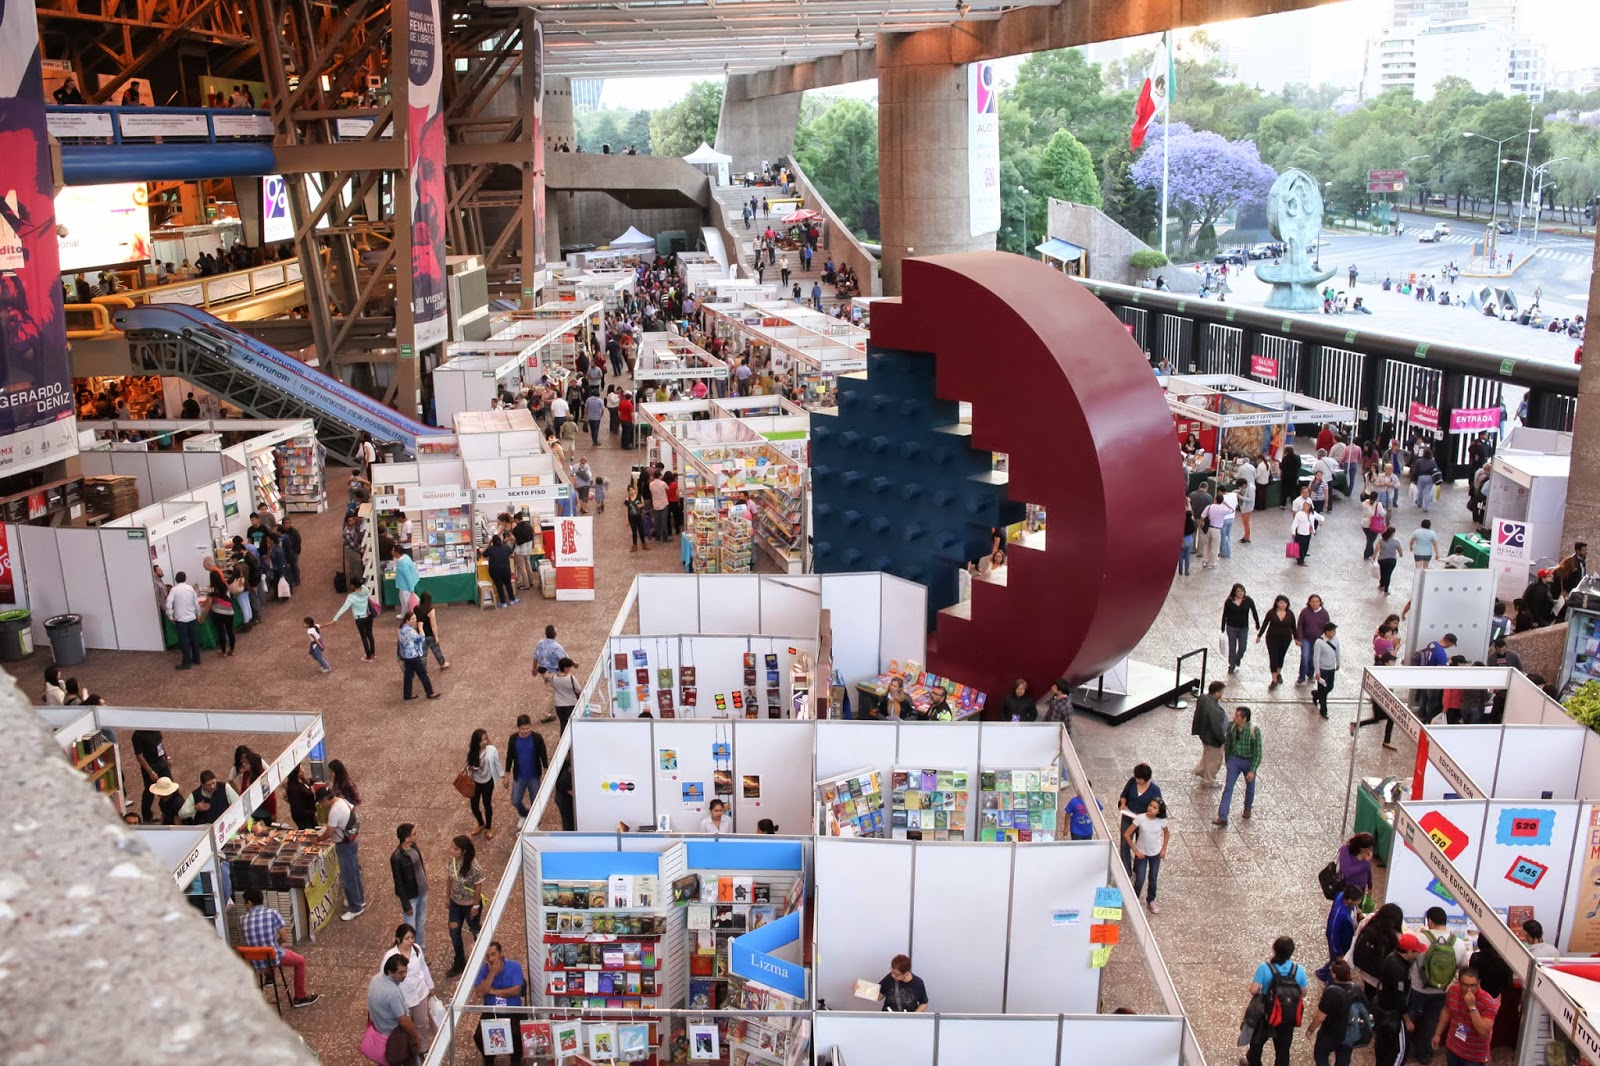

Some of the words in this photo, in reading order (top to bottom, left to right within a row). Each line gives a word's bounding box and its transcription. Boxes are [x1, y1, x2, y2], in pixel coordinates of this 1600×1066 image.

[410, 20, 434, 35] REMATE
[410, 31, 417, 42] DE
[0, 382, 62, 409] GERARDO
[256, 361, 290, 383] HYUNDAI
[300, 384, 316, 397] NEW
[348, 409, 364, 421] NEW
[271, 355, 305, 375] HYUNDAI
[314, 377, 329, 389] NEW
[361, 402, 377, 413] NEW
[36, 391, 70, 413] DENIZ
[1456, 415, 1493, 423] ENTRADA
[422, 492, 455, 500] PARANINFO
[1366, 681, 1384, 704] ESTUDIOS
[1390, 704, 1410, 733] MUJERES
[1373, 680, 1408, 718] DOCUMENTACION
[1439, 756, 1462, 788] EDICIONES
[1463, 784, 1473, 799] EON
[1515, 822, 1537, 830] $20
[1430, 833, 1447, 849] $30
[176, 849, 199, 880] MEXICO
[1518, 864, 1538, 878] $45
[1430, 851, 1449, 879] EDEBE
[1450, 874, 1483, 918] EDICIONES
[750, 953, 789, 979] Lizma
[1537, 977, 1543, 988] 7
[1563, 1007, 1600, 1059] INTITU
